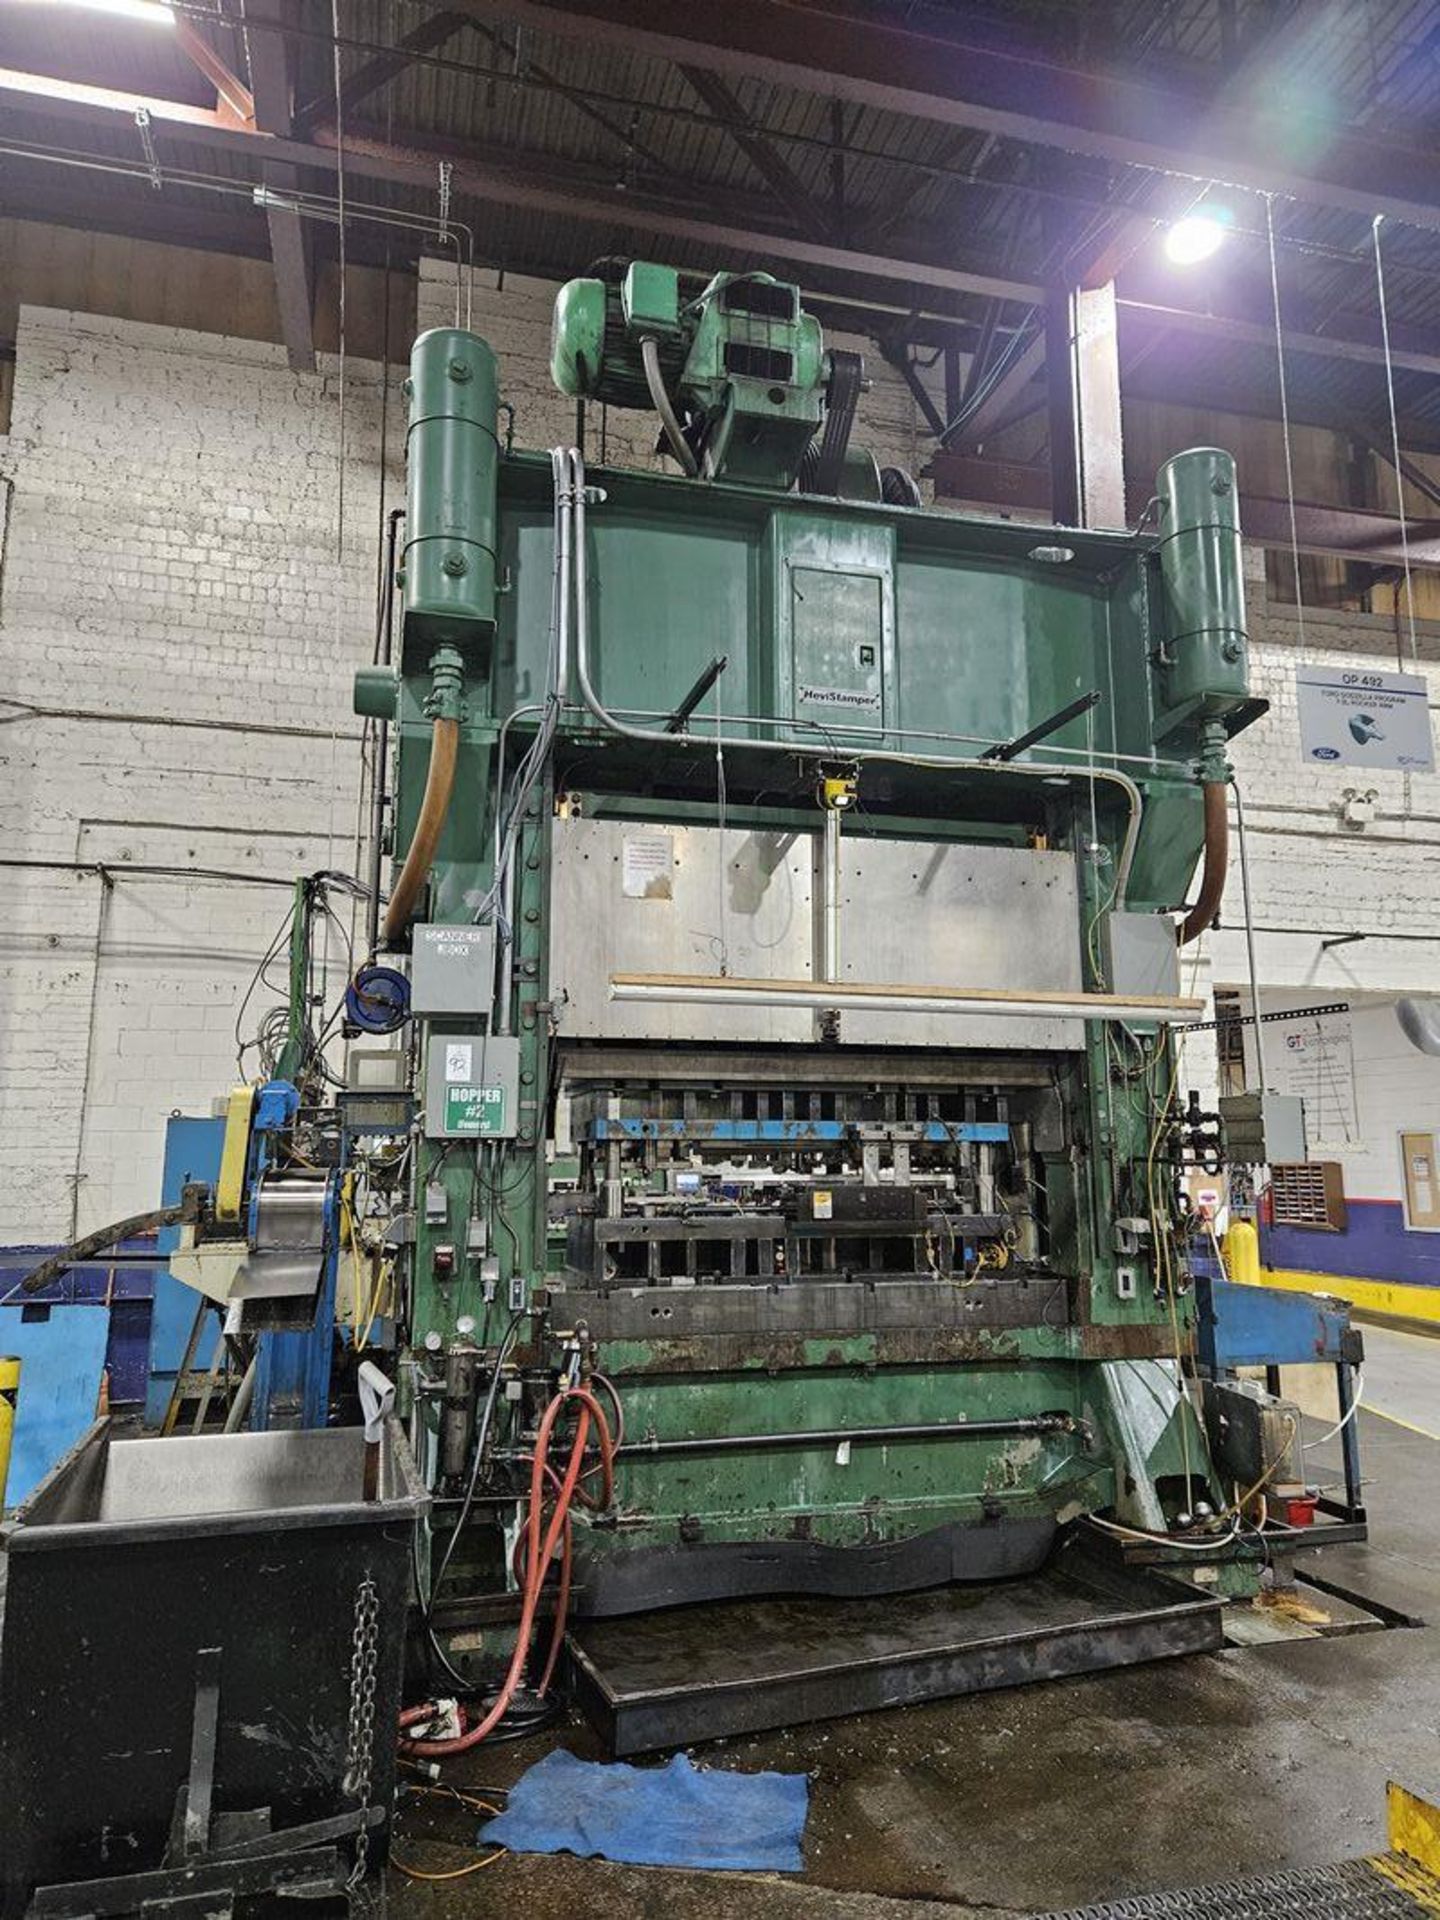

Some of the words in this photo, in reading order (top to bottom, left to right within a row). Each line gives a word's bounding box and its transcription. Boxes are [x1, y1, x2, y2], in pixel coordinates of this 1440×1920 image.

[1342, 674, 1359, 685] OP
[1361, 675, 1384, 688] 492
[803, 689, 877, 705] HeviStamper
[1287, 1034, 1302, 1048] GT
[450, 1088, 502, 1103] HOPPER
[464, 1104, 486, 1118] #2
